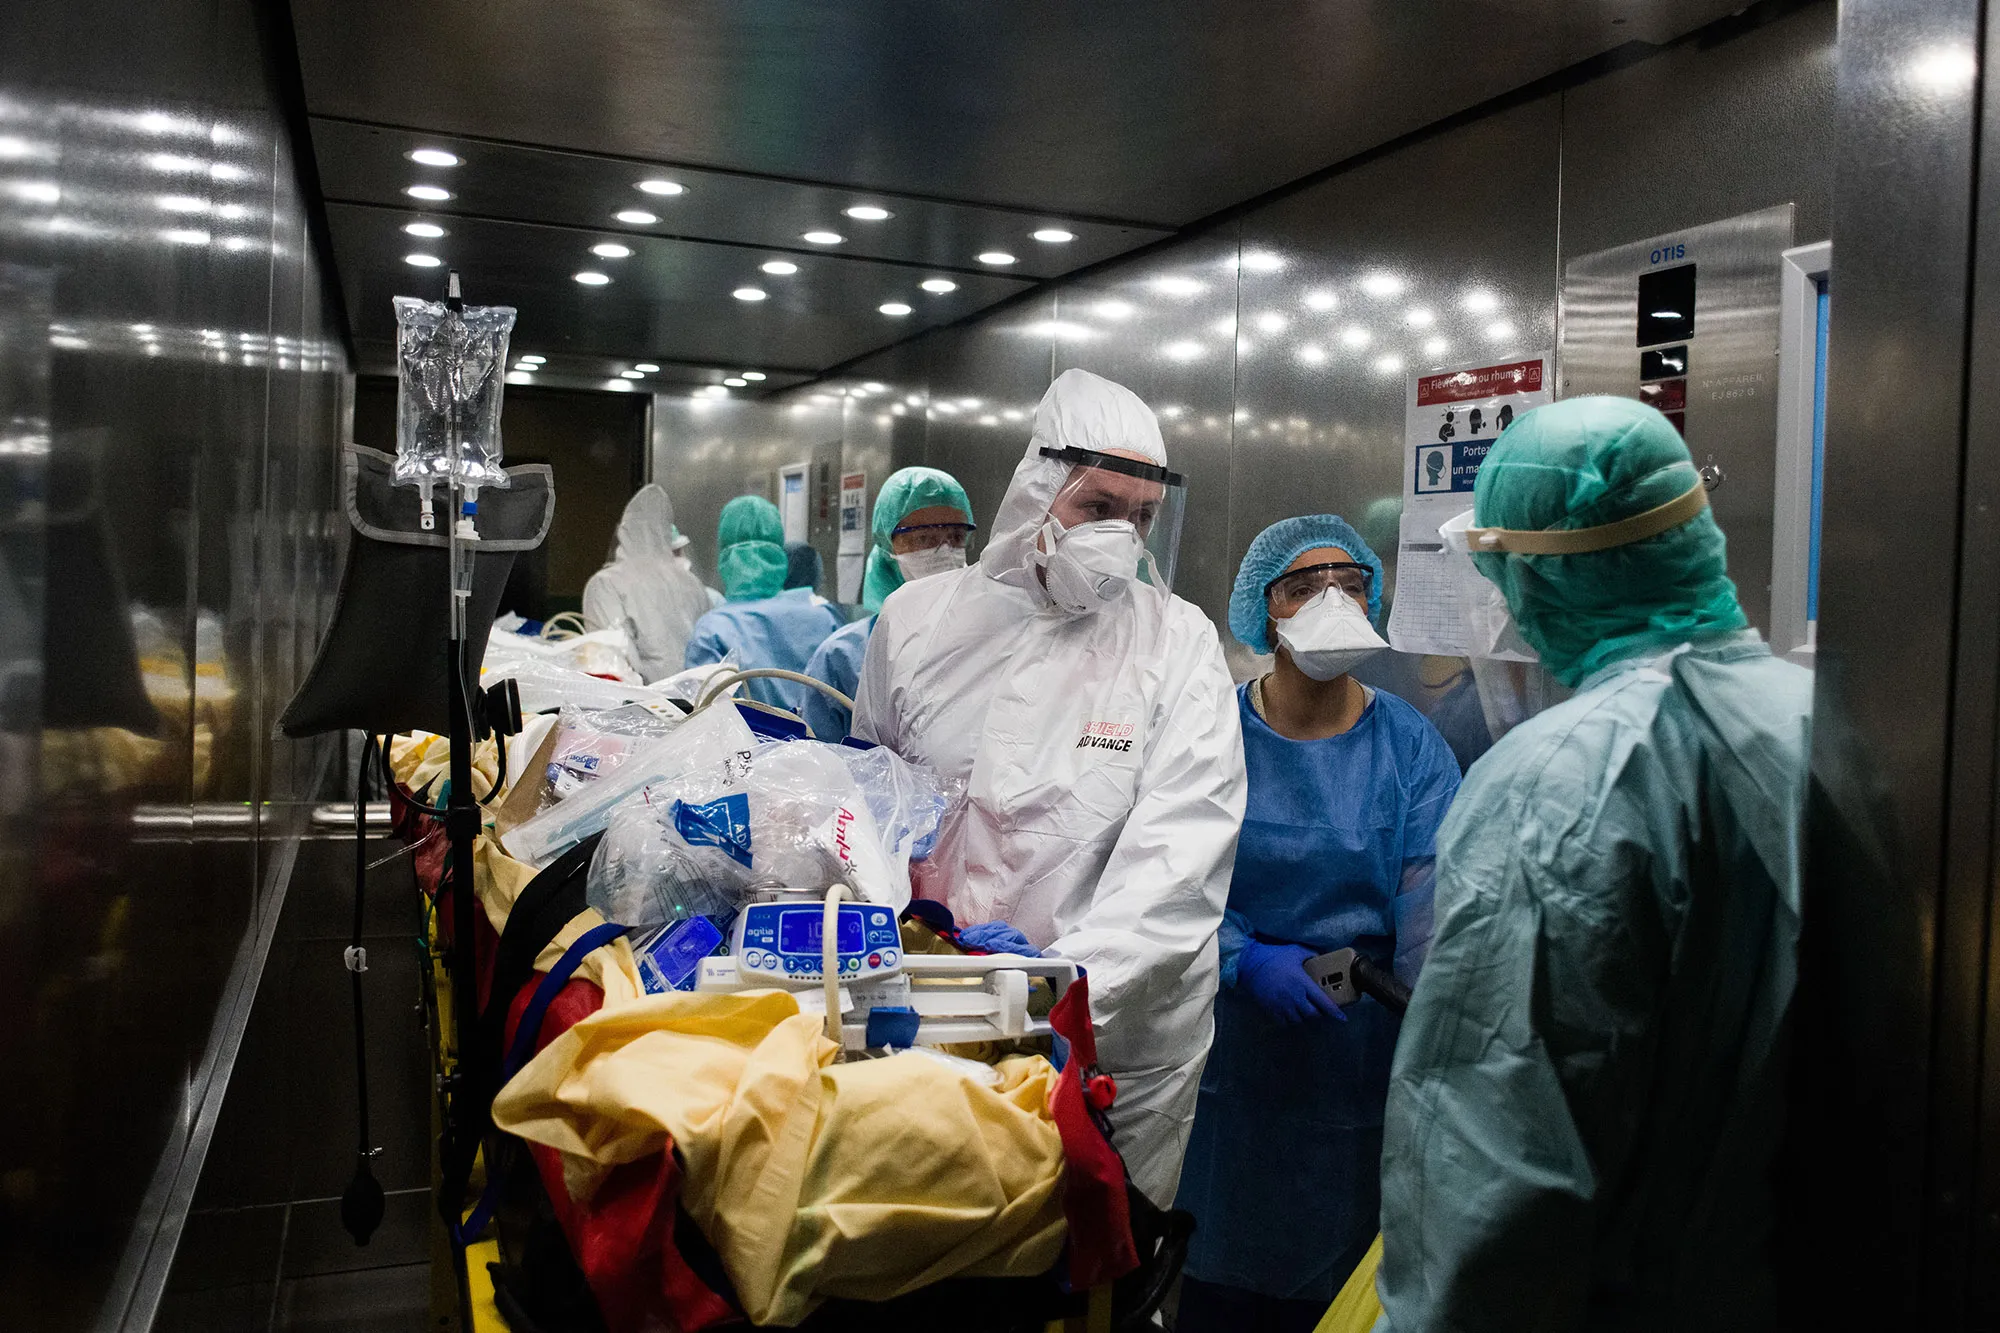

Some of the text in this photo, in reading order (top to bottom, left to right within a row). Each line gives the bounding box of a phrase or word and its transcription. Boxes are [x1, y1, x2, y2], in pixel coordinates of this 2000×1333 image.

[1650, 244, 1685, 264] OTIS
[1479, 373, 1489, 383] ou
[1453, 466, 1464, 475] un
[1076, 735, 1133, 752] ADVANCE
[747, 926, 774, 937] agilia
